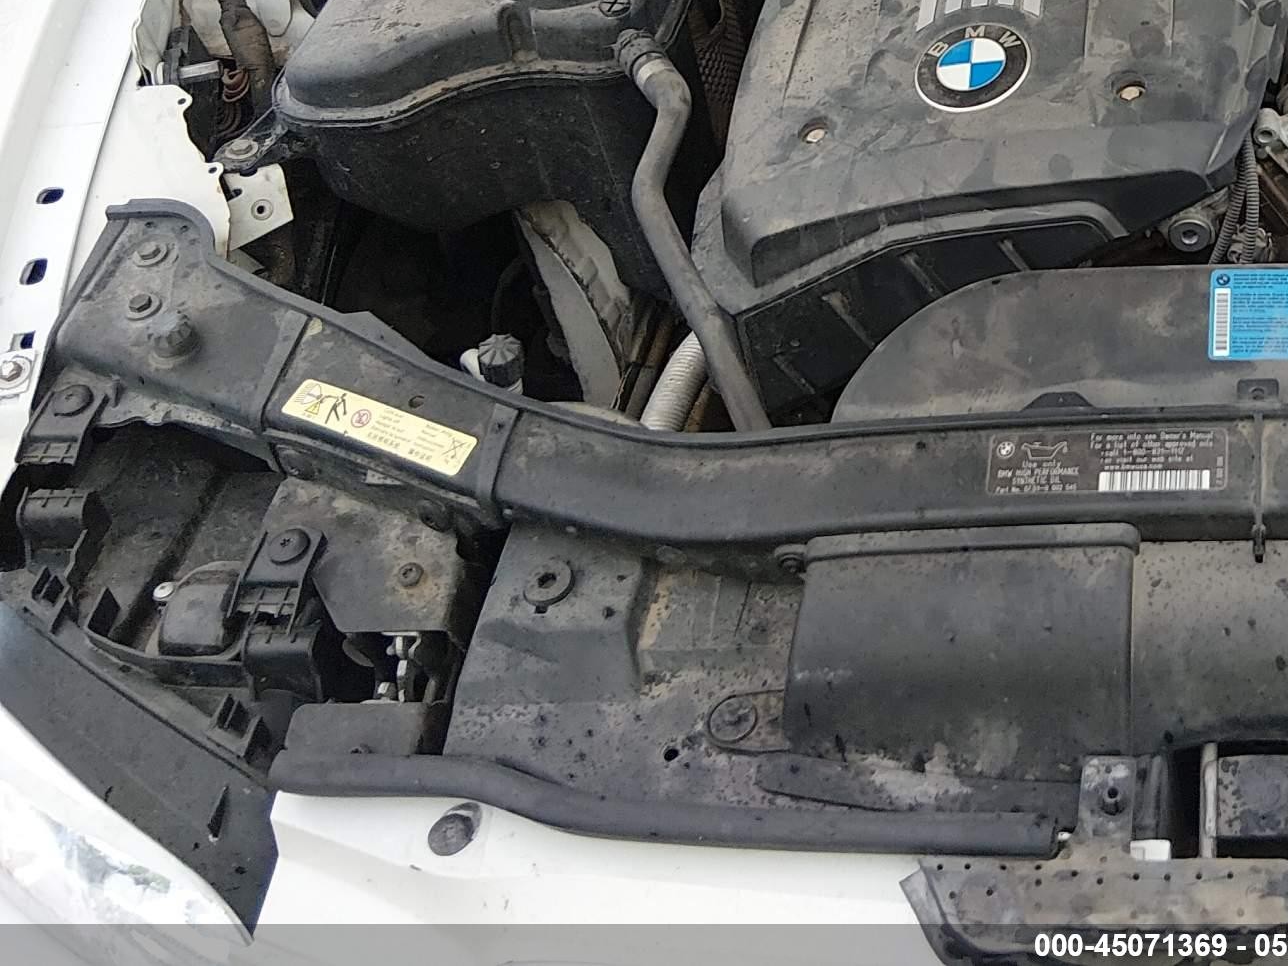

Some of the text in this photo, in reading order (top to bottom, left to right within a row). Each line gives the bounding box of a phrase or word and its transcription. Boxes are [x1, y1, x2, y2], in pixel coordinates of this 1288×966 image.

[927, 25, 1022, 58] BMW
[1189, 431, 1213, 439] Manual
[1022, 459, 1061, 469] Use only
[998, 468, 1013, 477] BMW
[1034, 466, 1079, 475] PERFORMANCE
